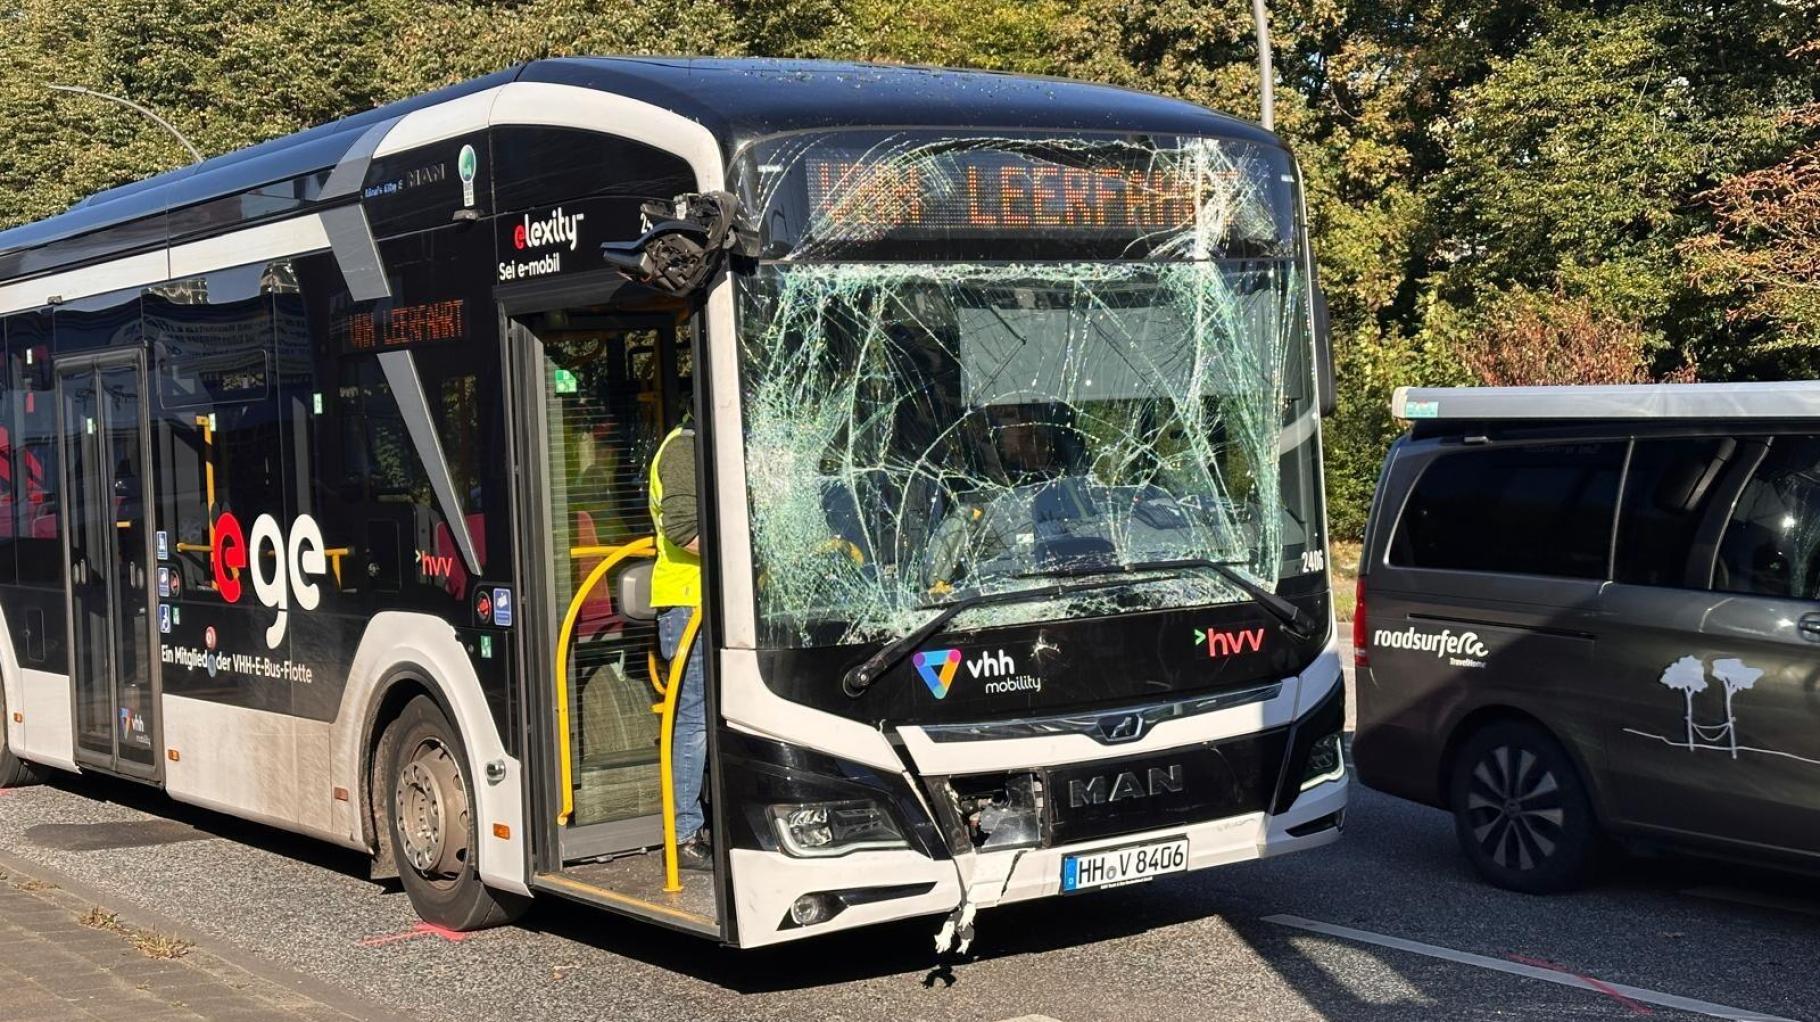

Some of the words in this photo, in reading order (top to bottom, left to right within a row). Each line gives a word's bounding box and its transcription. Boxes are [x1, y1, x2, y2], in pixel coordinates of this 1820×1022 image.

[499, 260, 516, 281] Sei
[517, 252, 560, 277] e-mobil
[421, 550, 453, 577] hvv
[1301, 549, 1324, 573] 2406
[1207, 628, 1264, 657] hvv
[161, 644, 174, 662] Ein
[174, 646, 208, 670] Mitglied
[215, 651, 232, 671] der
[232, 653, 313, 683] VHH-E-Bus-Flotte
[966, 649, 1015, 679] vhh
[985, 675, 1041, 694] mobility
[1068, 764, 1184, 808] MAN
[1078, 857, 1105, 884] HH
[1119, 853, 1132, 877] V
[1135, 844, 1184, 874] 8406
